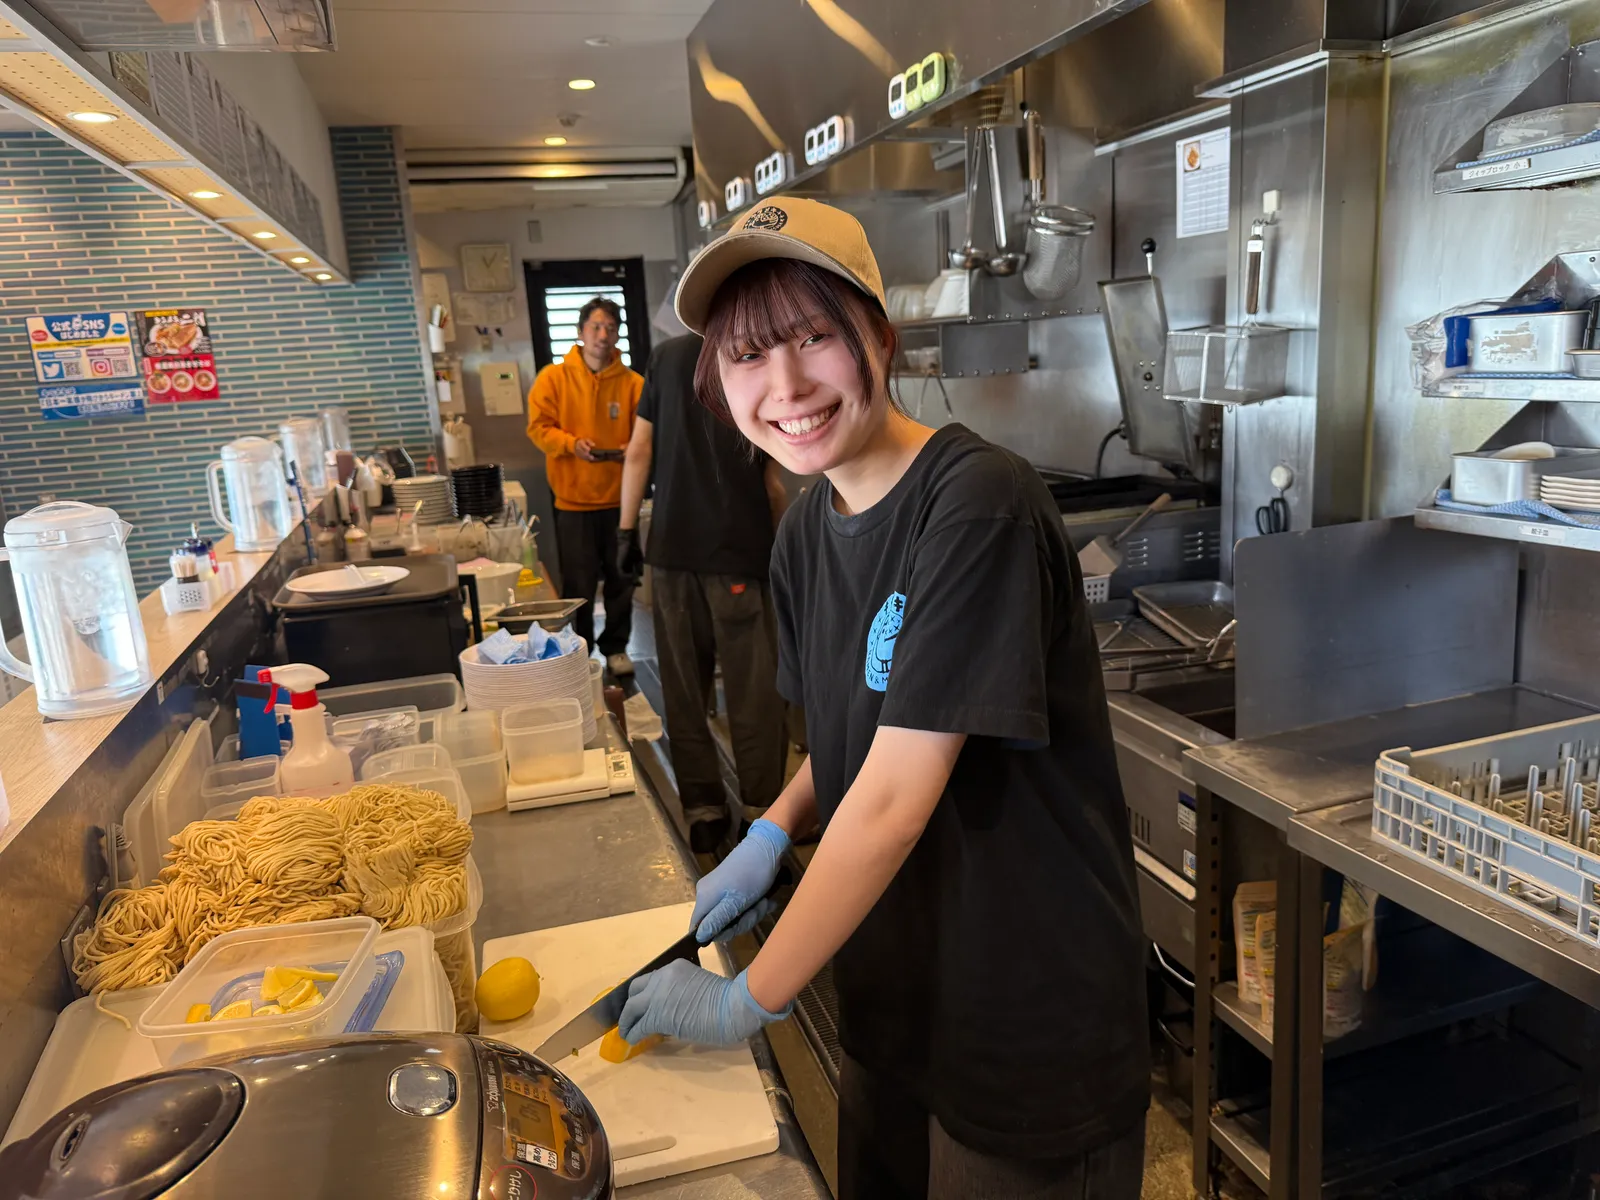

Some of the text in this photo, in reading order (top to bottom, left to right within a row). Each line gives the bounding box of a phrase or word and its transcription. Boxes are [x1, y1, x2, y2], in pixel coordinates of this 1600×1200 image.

[51, 321, 72, 332] 公式
[83, 318, 106, 330] SNS
[60, 329, 101, 340] はじめました
[516, 1143, 526, 1159] 保温
[533, 1147, 542, 1163] 高め
[571, 1152, 581, 1170] 保温
